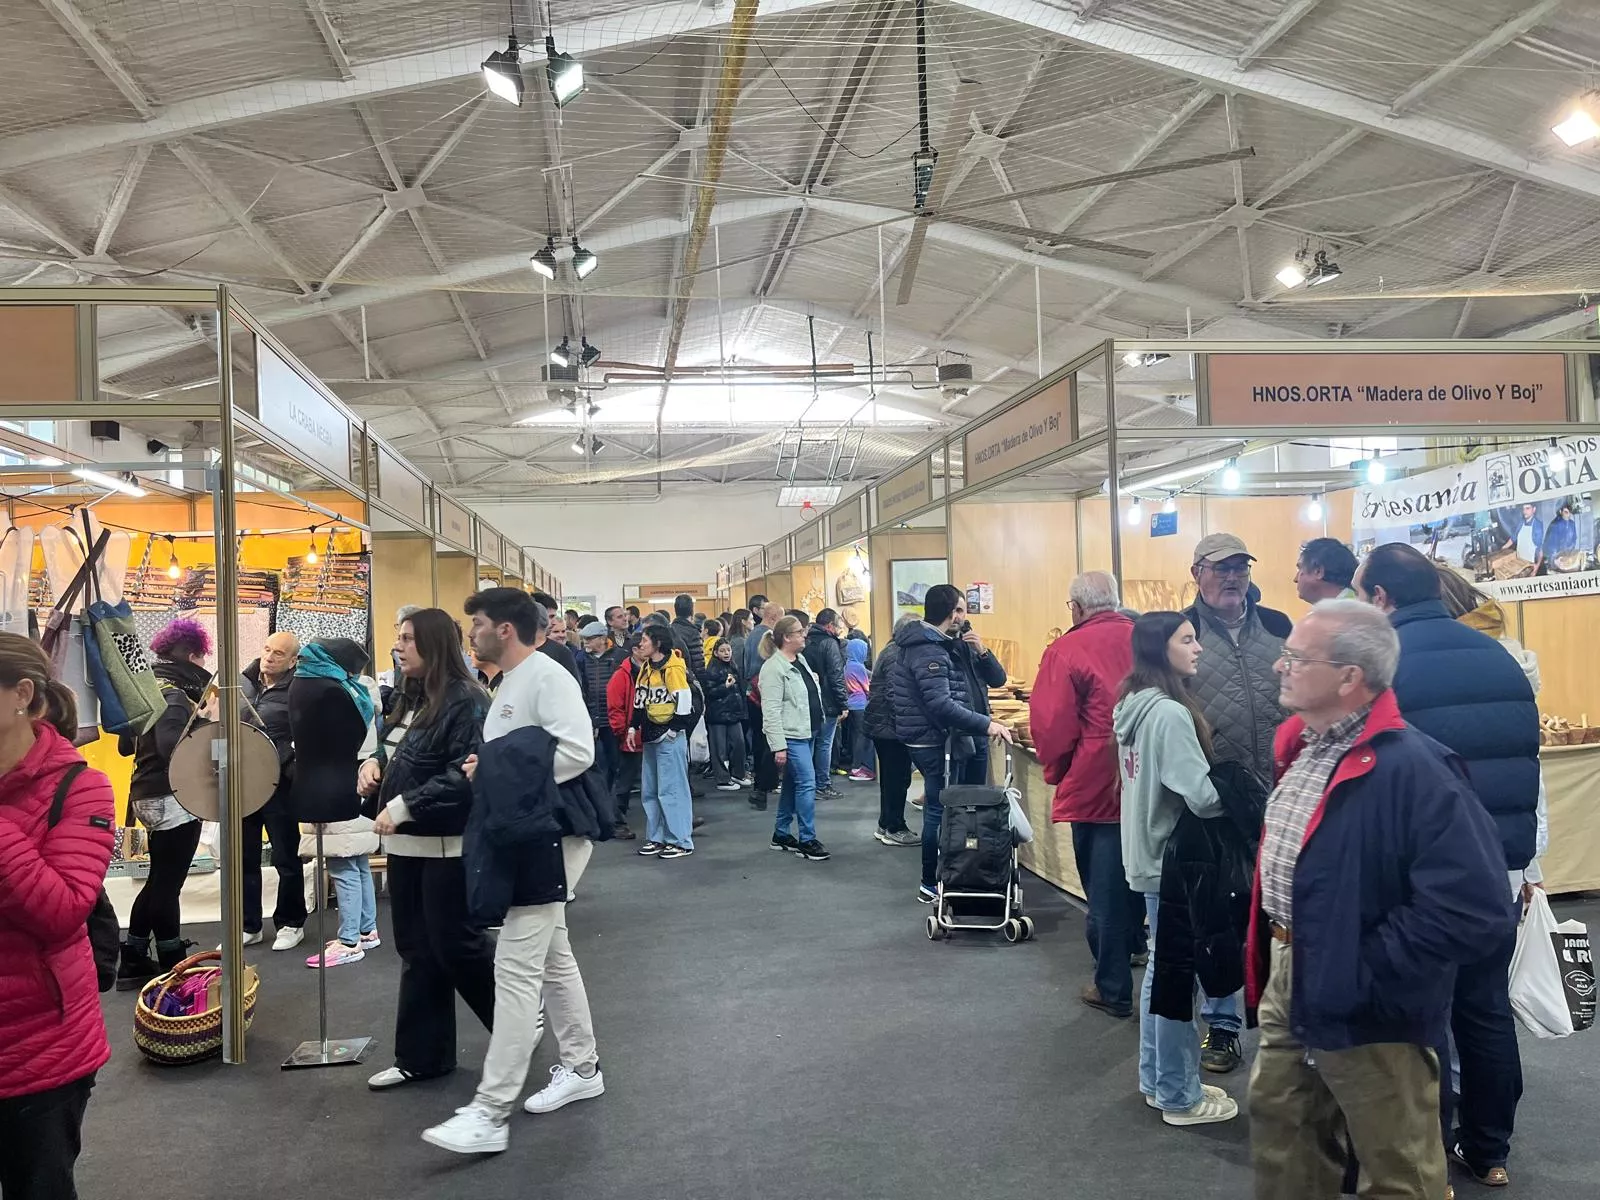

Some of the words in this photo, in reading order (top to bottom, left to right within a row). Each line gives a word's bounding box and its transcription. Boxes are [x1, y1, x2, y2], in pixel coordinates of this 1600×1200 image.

[1253, 385, 1352, 402] HNOS.ORTA
[1428, 385, 1446, 401] de
[1451, 384, 1491, 401] Olivo
[1495, 384, 1505, 399] Y
[1029, 423, 1043, 439] Olivo
[1518, 455, 1599, 494] ORTA
